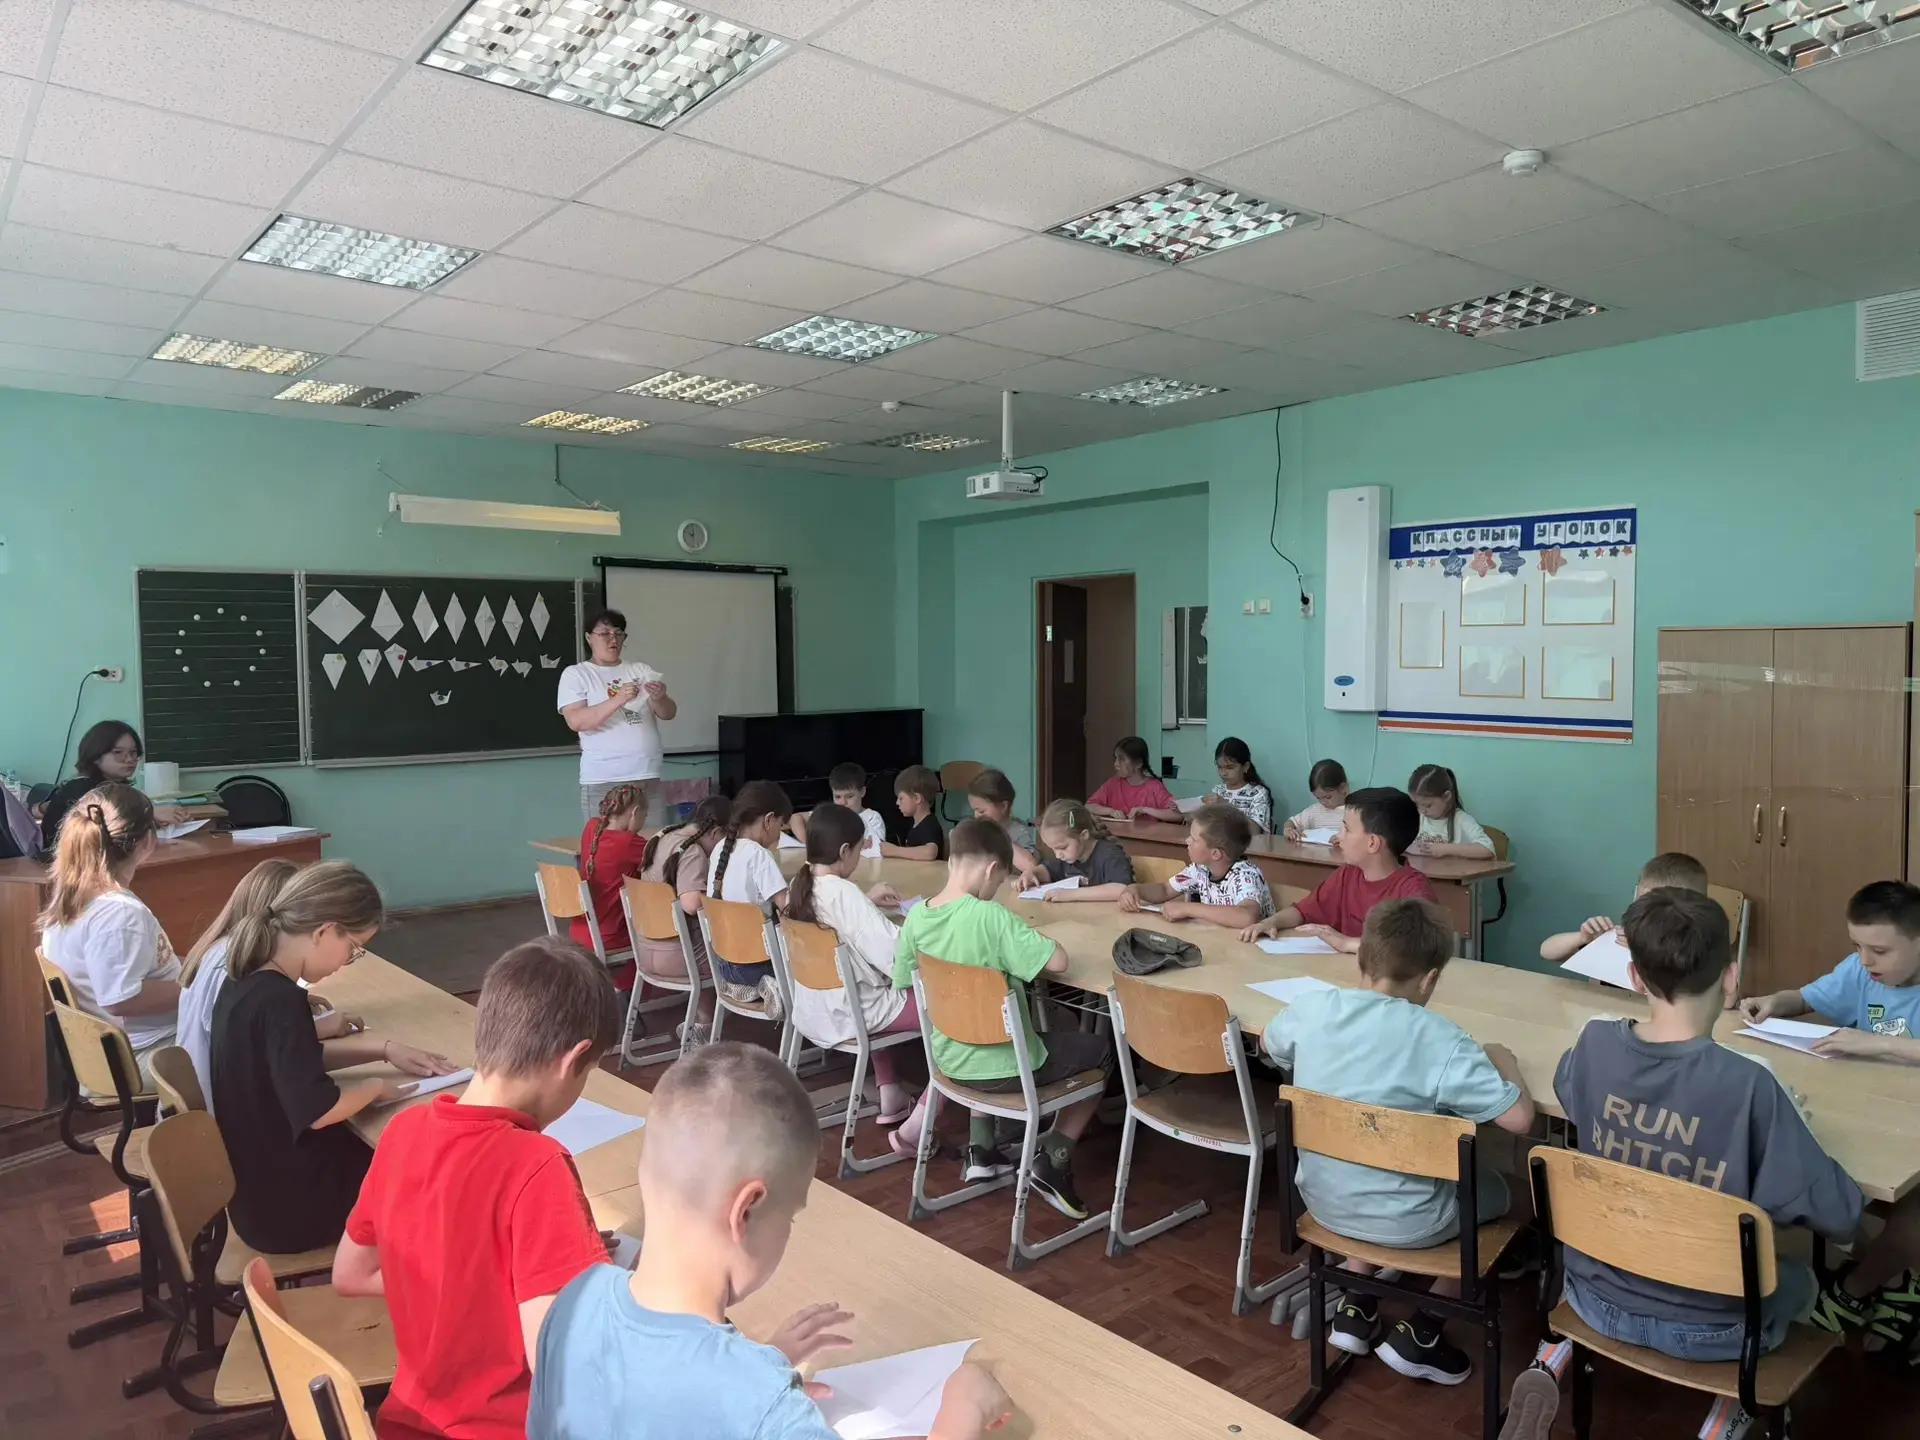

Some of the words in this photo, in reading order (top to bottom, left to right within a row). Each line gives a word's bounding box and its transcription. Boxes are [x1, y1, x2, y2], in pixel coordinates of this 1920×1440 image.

[1412, 526, 1519, 545] КЛАССНЫЙ
[1537, 520, 1627, 537] УГОЛОК
[1602, 1093, 1700, 1146] RUN
